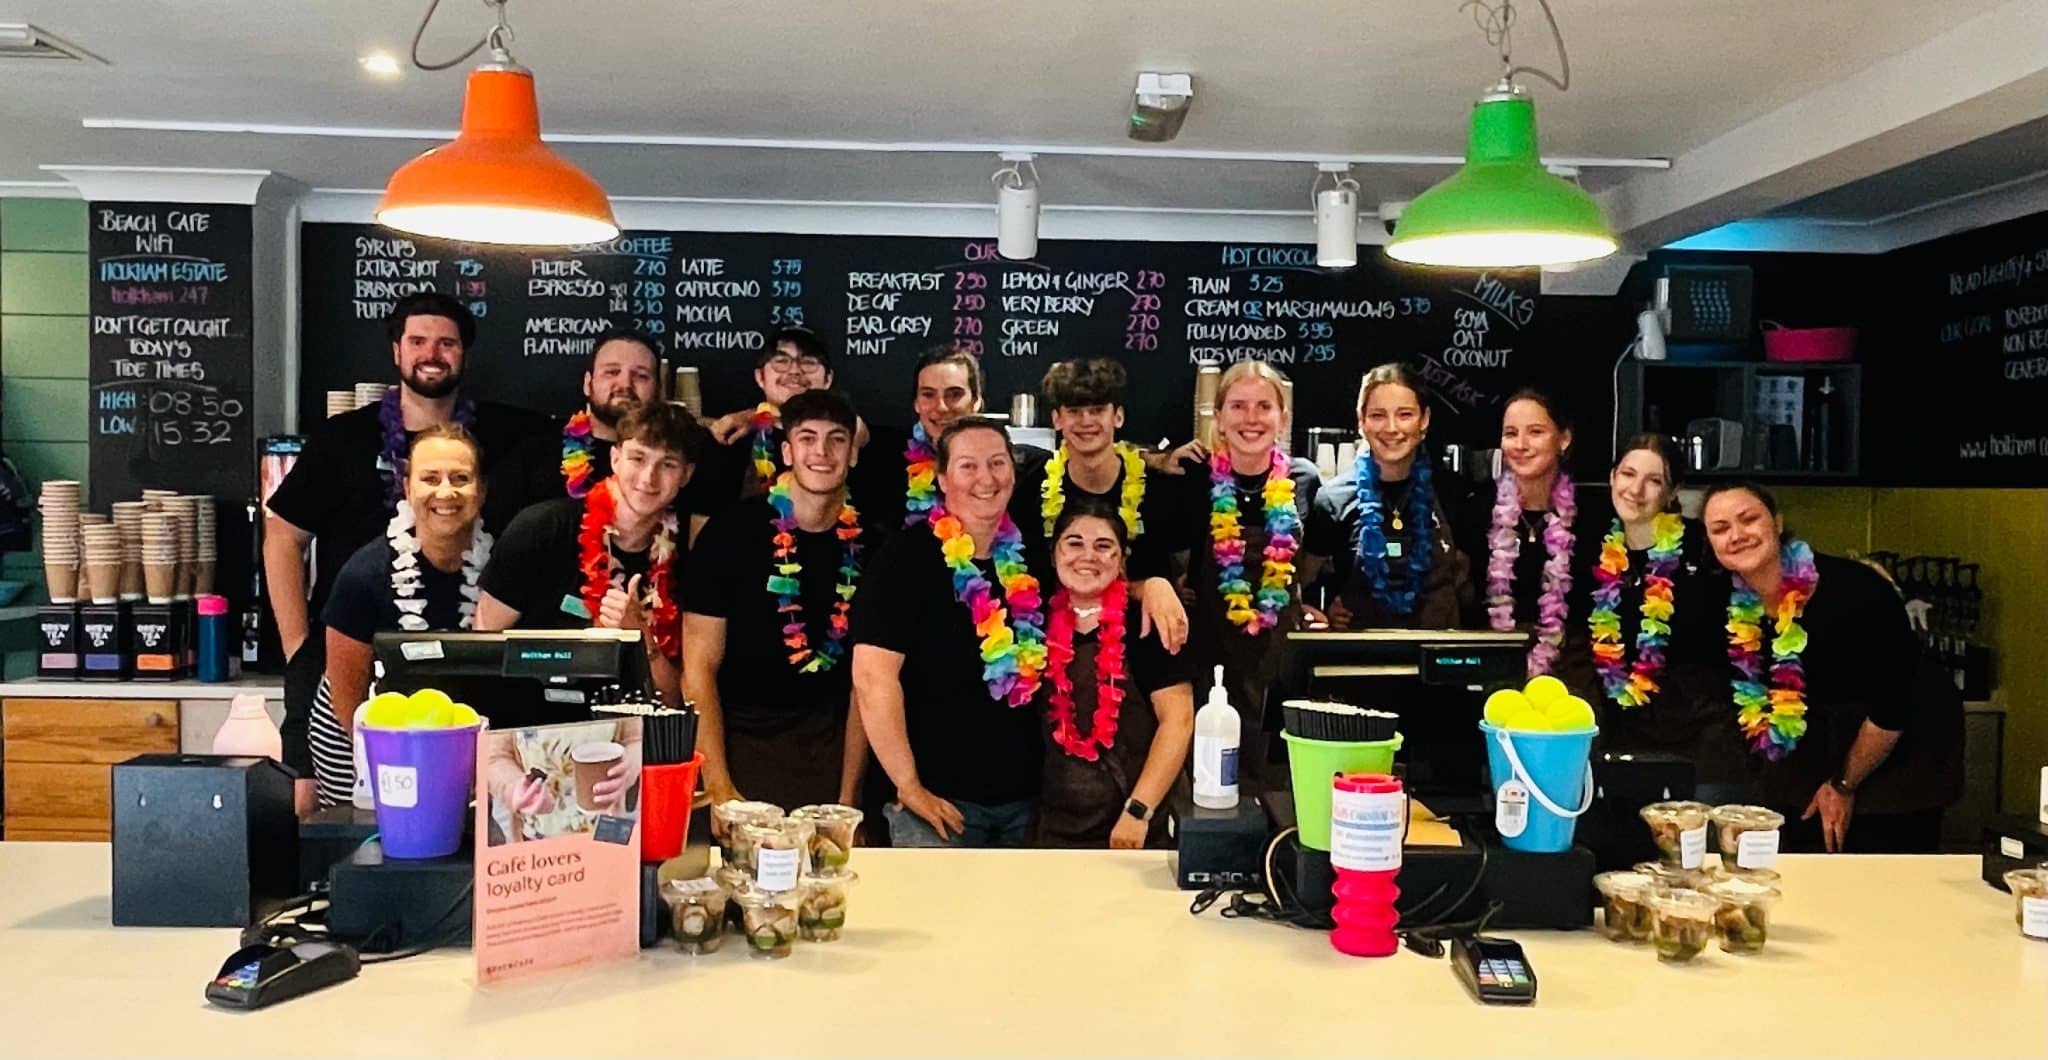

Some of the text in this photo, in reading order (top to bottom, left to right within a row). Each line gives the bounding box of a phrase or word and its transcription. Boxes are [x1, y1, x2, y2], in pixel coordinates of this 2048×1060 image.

[99, 209, 211, 232] BEACH CAFE
[355, 237, 417, 258] SYRUPS
[610, 236, 673, 254] COFFEE
[964, 243, 1000, 261] OUR
[1221, 245, 1255, 267] HOT
[101, 263, 229, 282] HOLKHAM ESTATE
[356, 259, 401, 278] EXTRA
[400, 259, 441, 278] SHOT
[531, 259, 588, 277] FILTER
[681, 257, 726, 276] LATTE
[528, 280, 605, 297] ESPRESSO
[675, 279, 761, 299] CAPPUCCINO
[848, 271, 945, 291] BREAKFAST
[1001, 271, 1050, 291] LEMON
[1064, 271, 1138, 297] GINGER
[1187, 276, 1231, 295] PLAIN
[1001, 295, 1041, 315] VERY
[1043, 295, 1095, 317] BERRY
[1473, 271, 1536, 326] MILKS
[676, 304, 733, 324] MOCHA
[1184, 299, 1240, 317] CREAM
[1242, 300, 1264, 320] OR
[1265, 299, 1396, 319] MARSHMALLOWS
[1454, 307, 1490, 328] SOYA
[137, 318, 171, 335] GET
[173, 317, 231, 337] CAUGHT
[847, 315, 889, 335] EARL
[890, 315, 932, 338] GREY
[1001, 319, 1059, 344] GREEN
[1186, 323, 1227, 343] FULLY
[1229, 323, 1287, 341] LOADED
[127, 338, 192, 359] TODAY'S
[674, 330, 765, 350] MACCHIATO
[846, 336, 896, 356] MINT
[1001, 340, 1039, 357] CHAI
[1453, 329, 1488, 348] OAT
[1189, 346, 1225, 364] KIDS
[1443, 347, 1513, 368] COCONUT
[111, 358, 205, 381] TIDE TIMES
[41, 623, 70, 632] BREW
[47, 631, 65, 639] TEA
[85, 624, 114, 633] BREW
[90, 632, 109, 641] TEA
[136, 624, 166, 633] BREW
[142, 632, 161, 640] TEA
[531, 853, 581, 870] lovers
[487, 867, 585, 899] loyalty card
